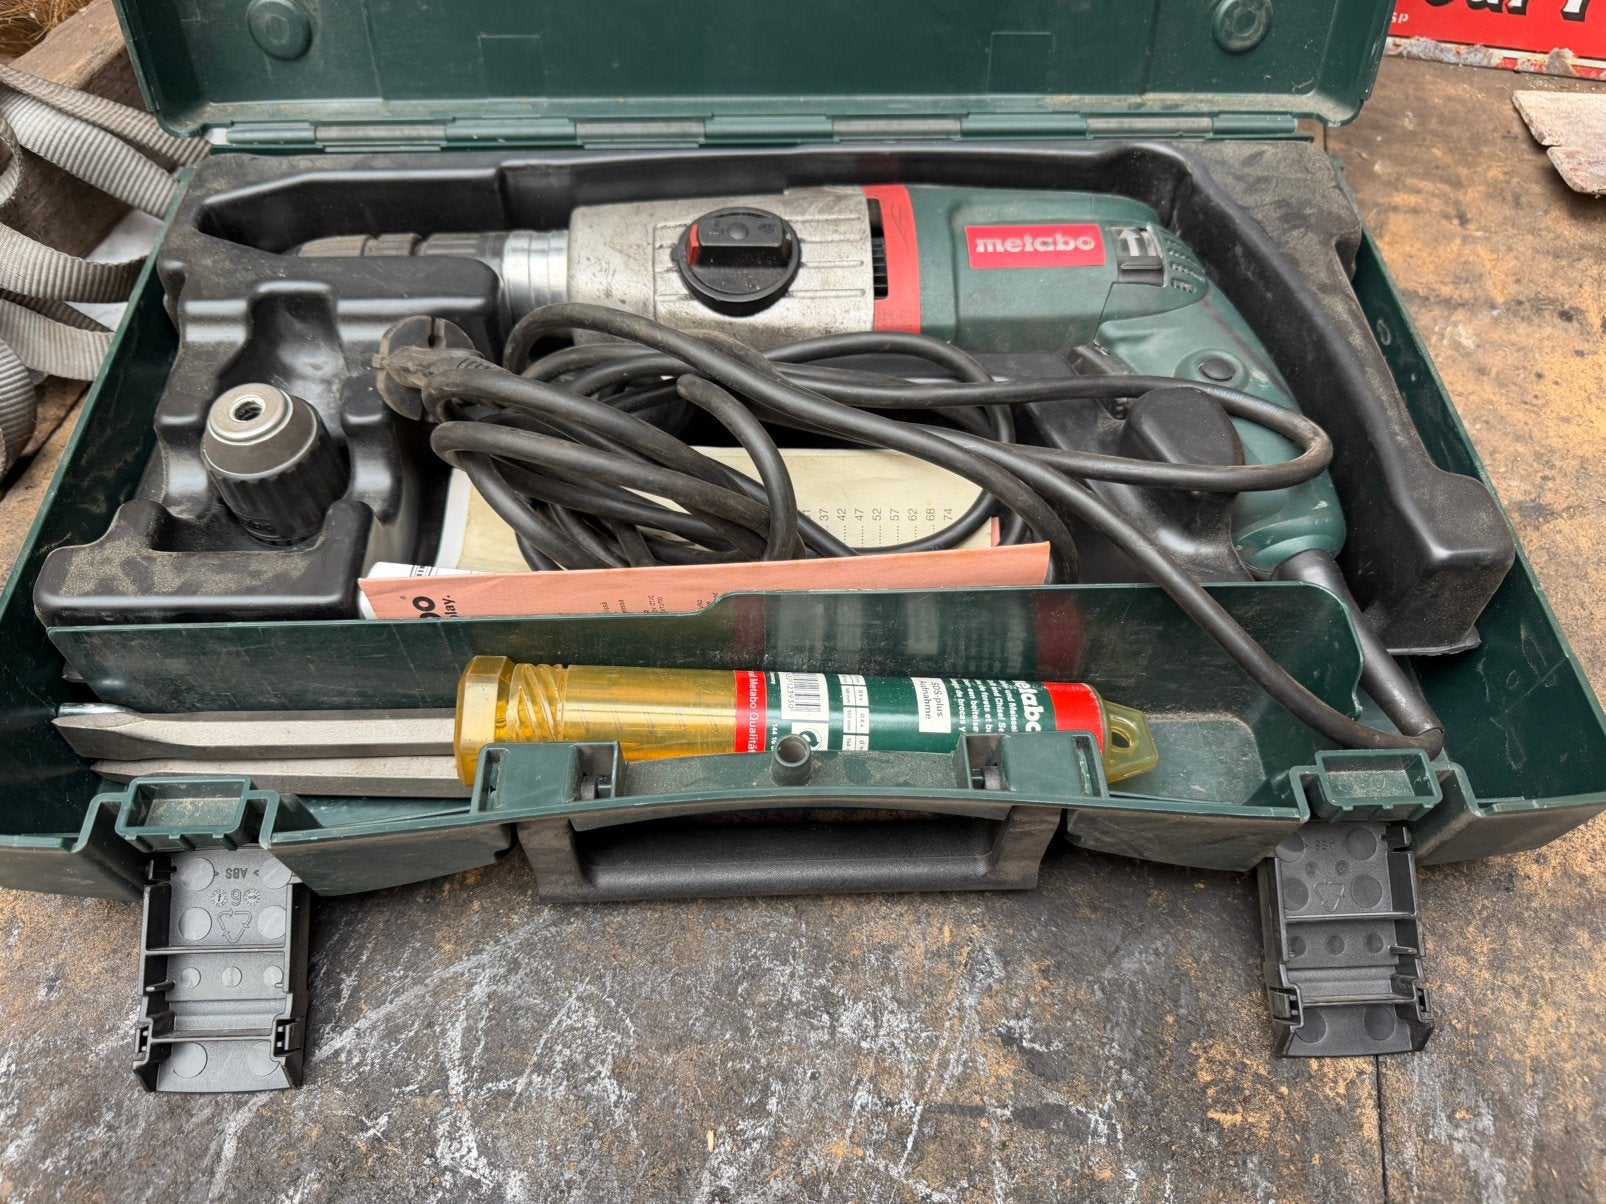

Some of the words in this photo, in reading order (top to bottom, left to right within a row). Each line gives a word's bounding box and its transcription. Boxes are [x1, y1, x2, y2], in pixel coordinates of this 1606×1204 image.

[975, 233, 1096, 253] metabo
[819, 508, 829, 521] 37
[837, 508, 846, 521] 42
[854, 508, 864, 521] 47
[872, 508, 882, 521] 52
[890, 508, 899, 521] 57
[908, 508, 918, 521] 62
[926, 508, 936, 521] 68
[944, 508, 952, 521] 74
[748, 678, 759, 709] Metabo
[919, 680, 932, 720] Aufnahme
[931, 682, 944, 717] SDS-plus
[958, 699, 966, 724] brocas
[995, 698, 1005, 720] Chisel
[225, 868, 248, 880] ABS
